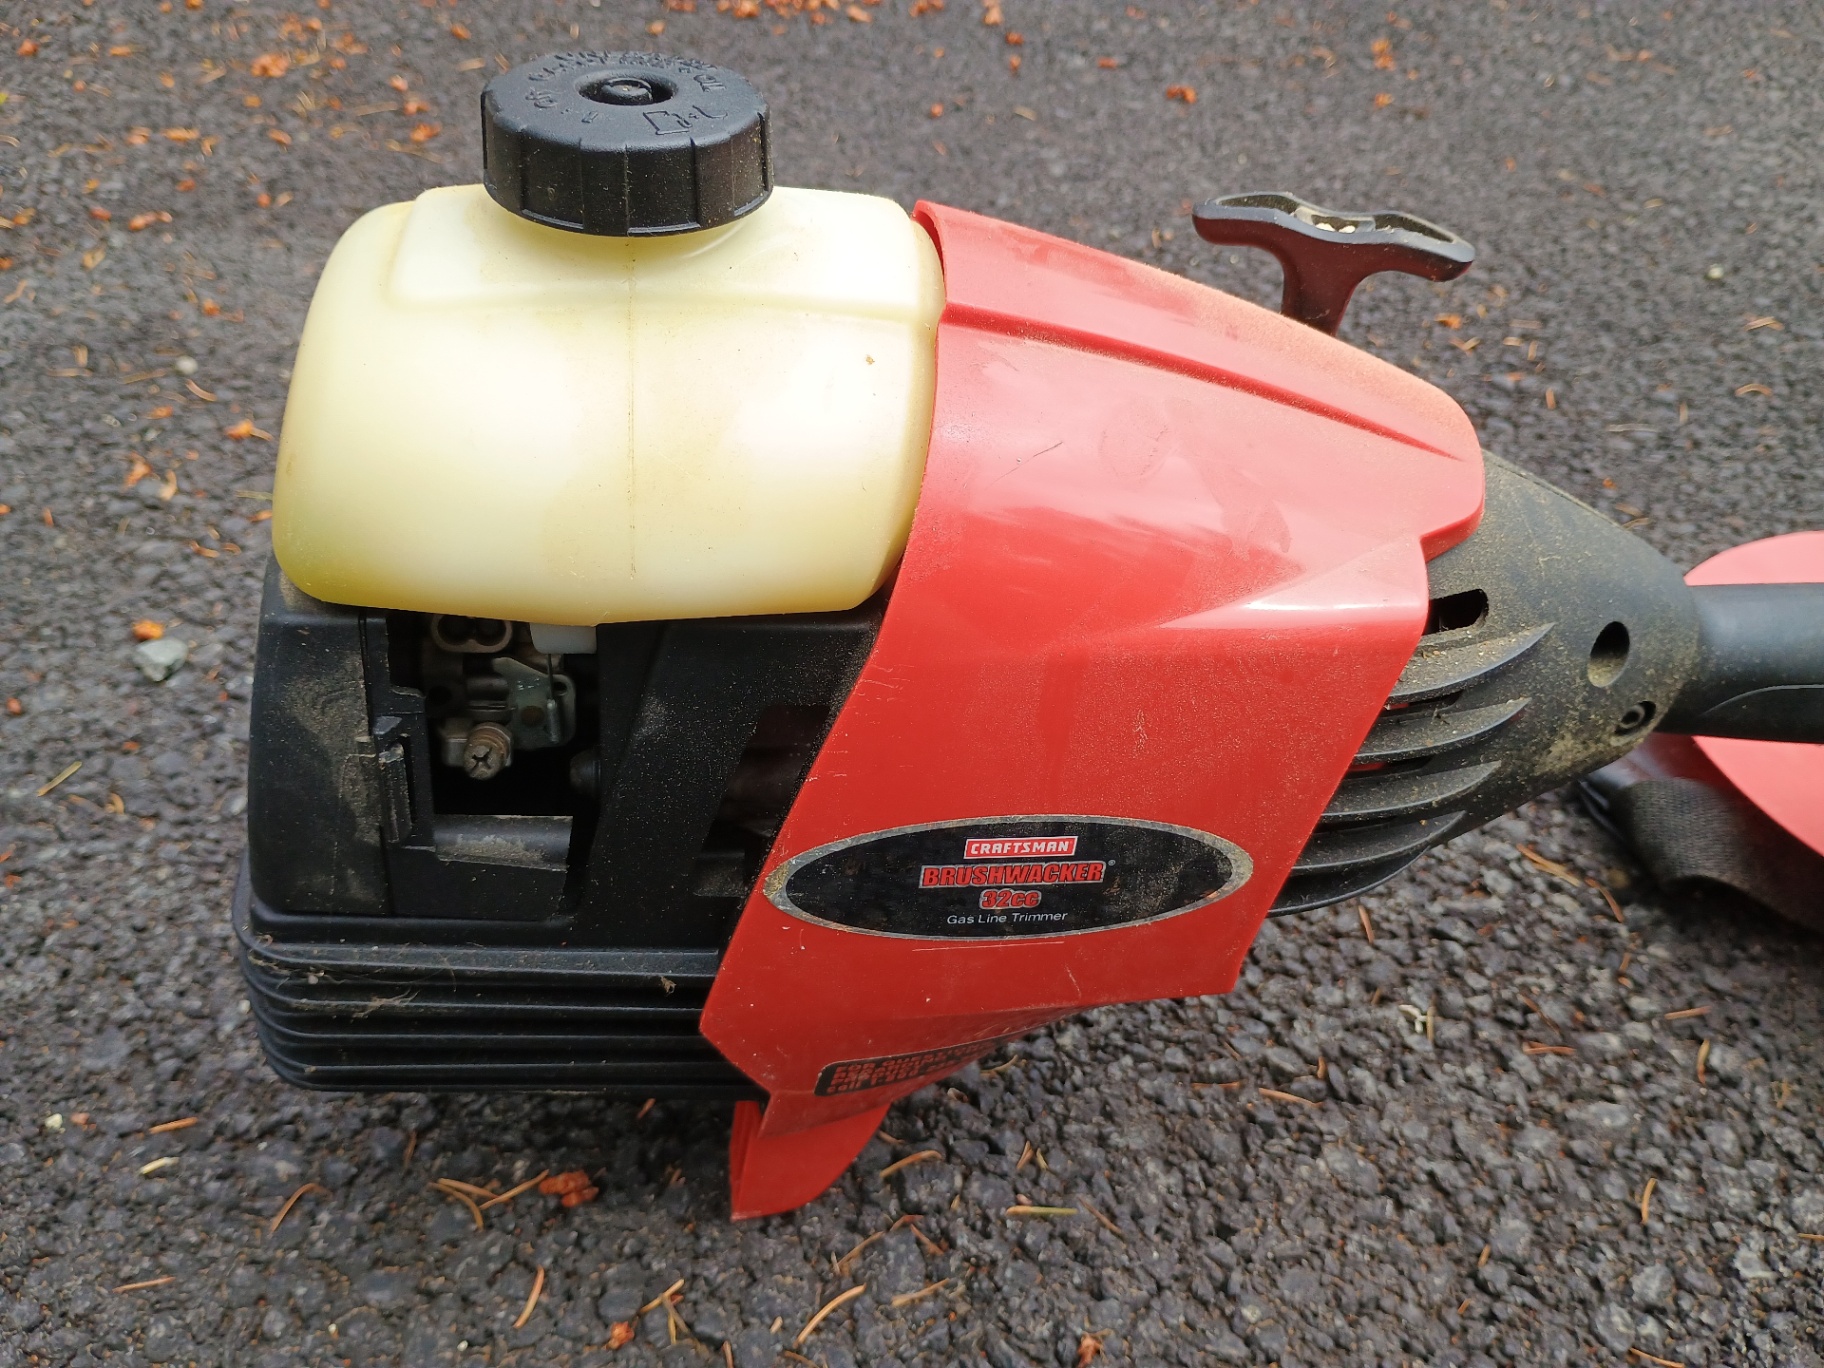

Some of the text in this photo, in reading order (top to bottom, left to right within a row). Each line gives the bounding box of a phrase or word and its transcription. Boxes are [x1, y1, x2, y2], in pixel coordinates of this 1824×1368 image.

[970, 839, 1070, 855] CRAFTSMAN
[920, 861, 1105, 888] BRUSHWACKER
[980, 889, 1041, 909] 32cc
[946, 911, 1069, 925] Gas Line Trimmer
